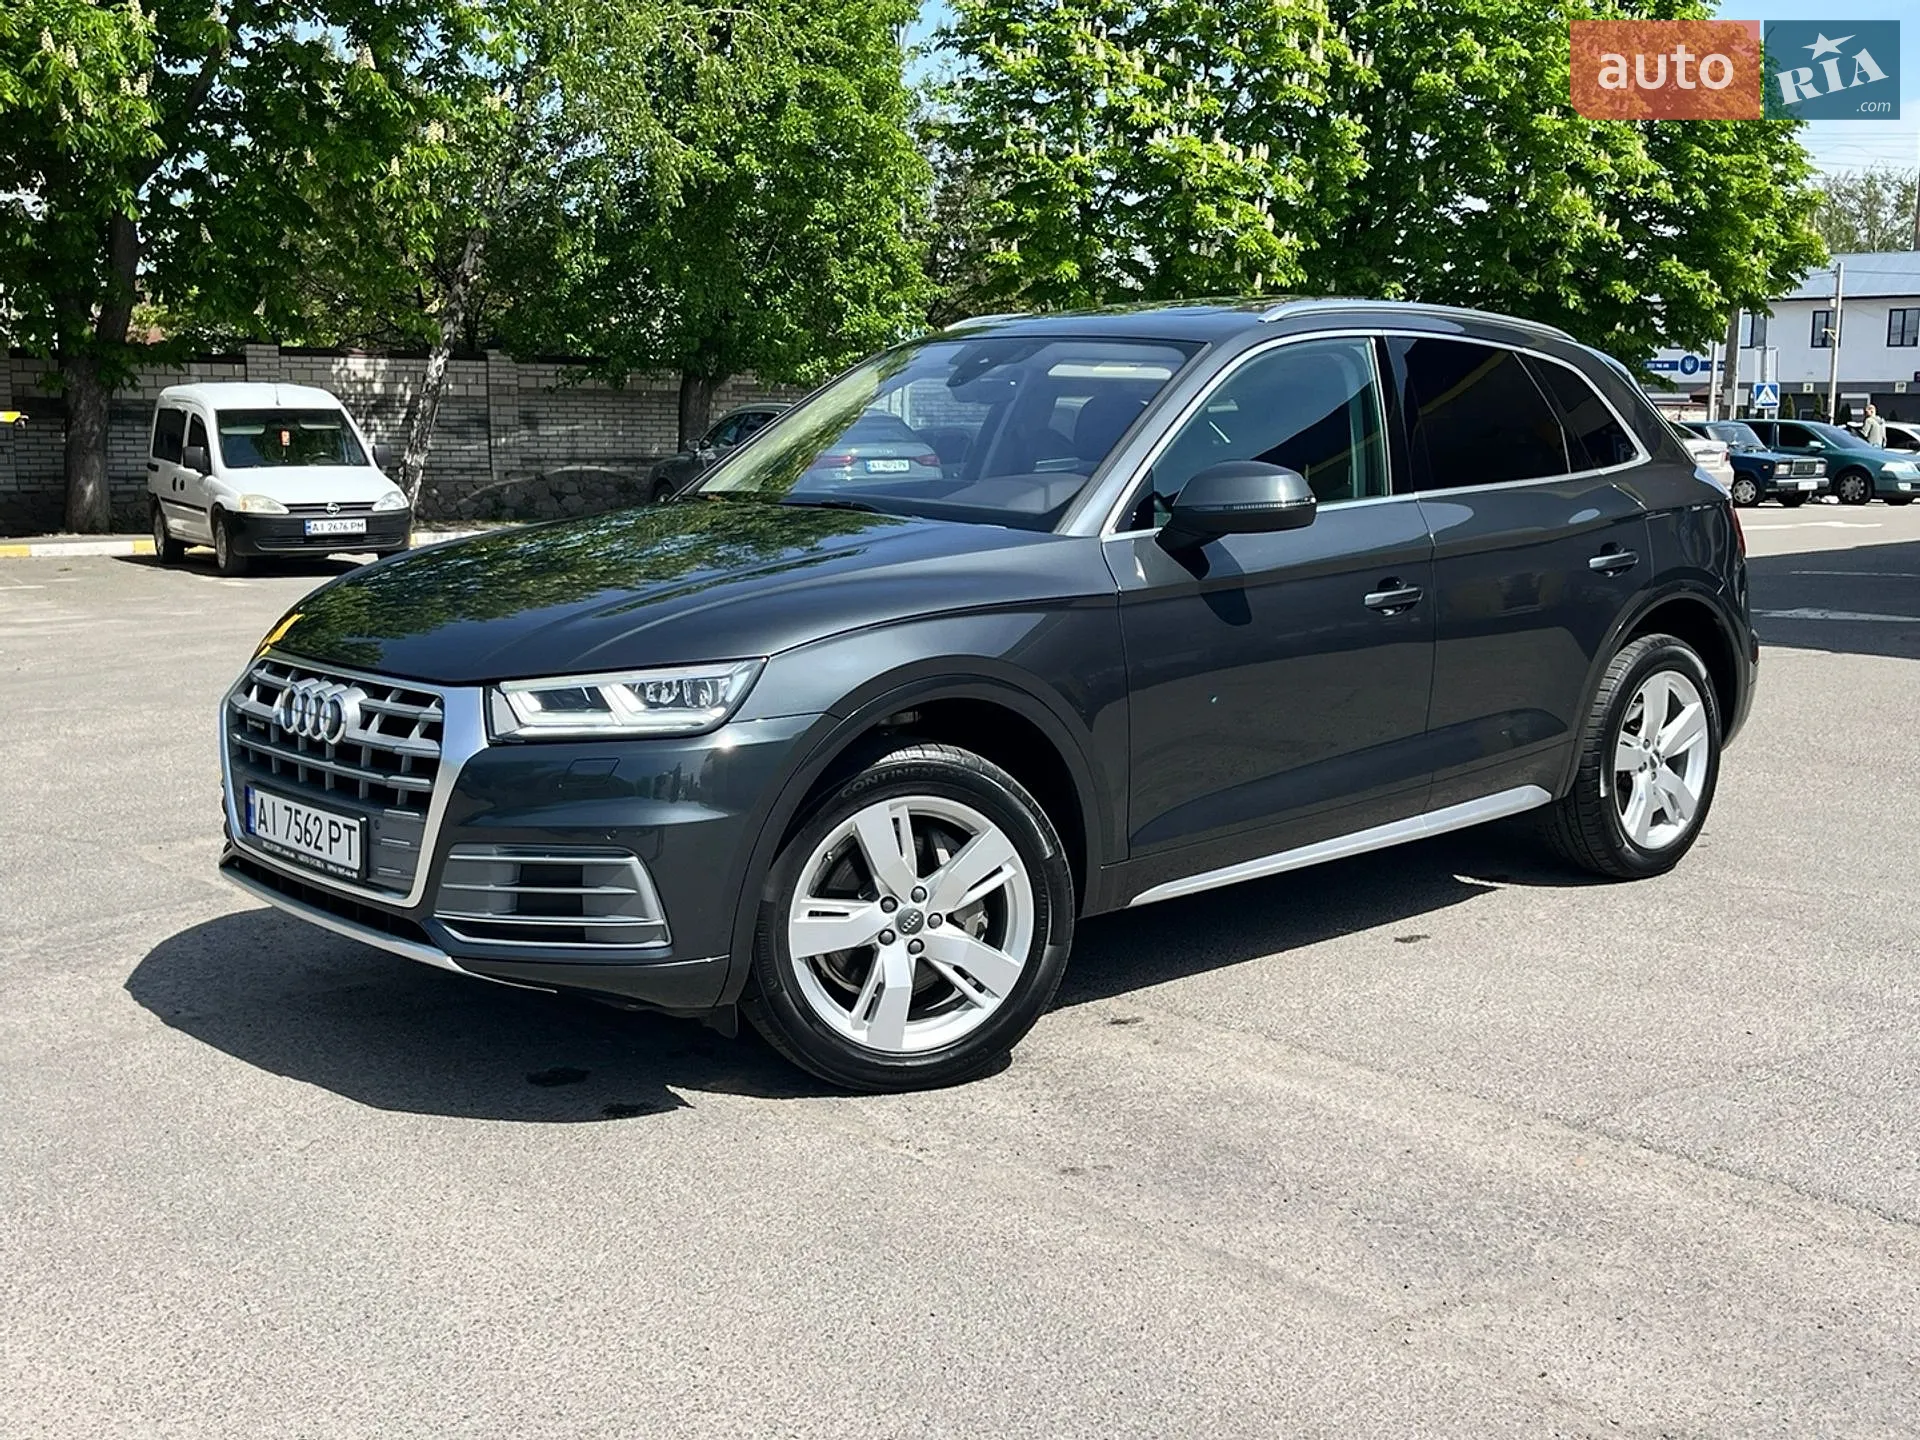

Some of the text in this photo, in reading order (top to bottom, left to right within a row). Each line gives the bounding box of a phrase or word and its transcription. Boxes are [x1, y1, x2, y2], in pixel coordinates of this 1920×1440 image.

[312, 523, 325, 532] AI
[327, 522, 349, 532] 2676
[257, 797, 277, 836] AI
[283, 804, 324, 853] 7562
[327, 818, 358, 862] PT
